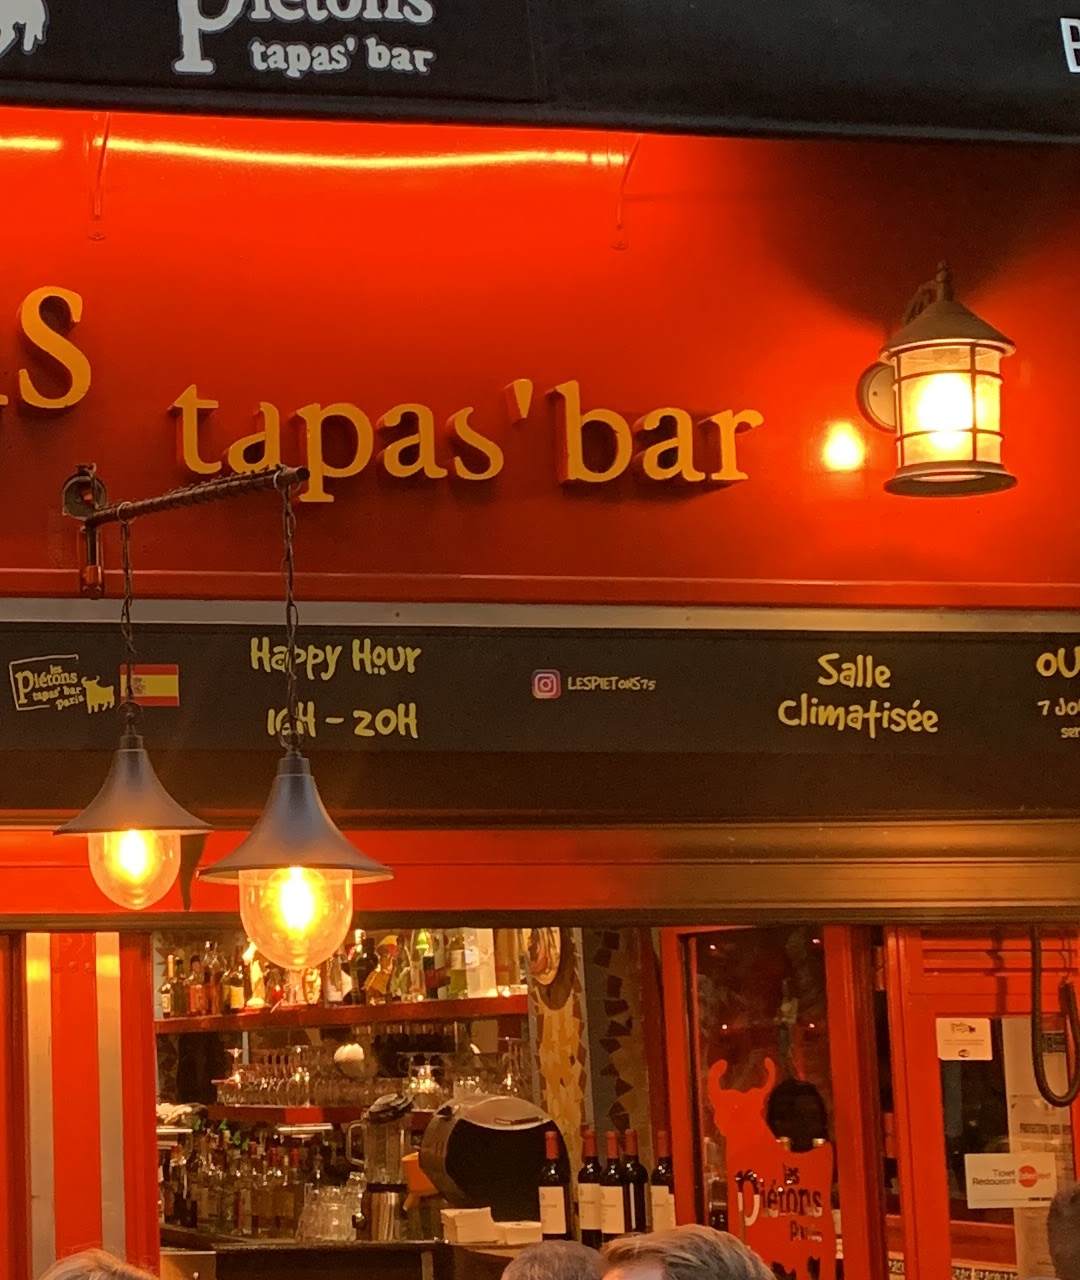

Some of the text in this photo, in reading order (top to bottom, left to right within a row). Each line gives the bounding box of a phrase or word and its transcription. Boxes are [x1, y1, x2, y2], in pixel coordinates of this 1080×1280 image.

[251, 39, 433, 77] tapas' bar
[250, 636, 422, 680] Happy Hour
[817, 652, 892, 688] Salle
[63, 685, 83, 696] bar
[1037, 699, 1051, 716] 7
[353, 703, 418, 739] 20H
